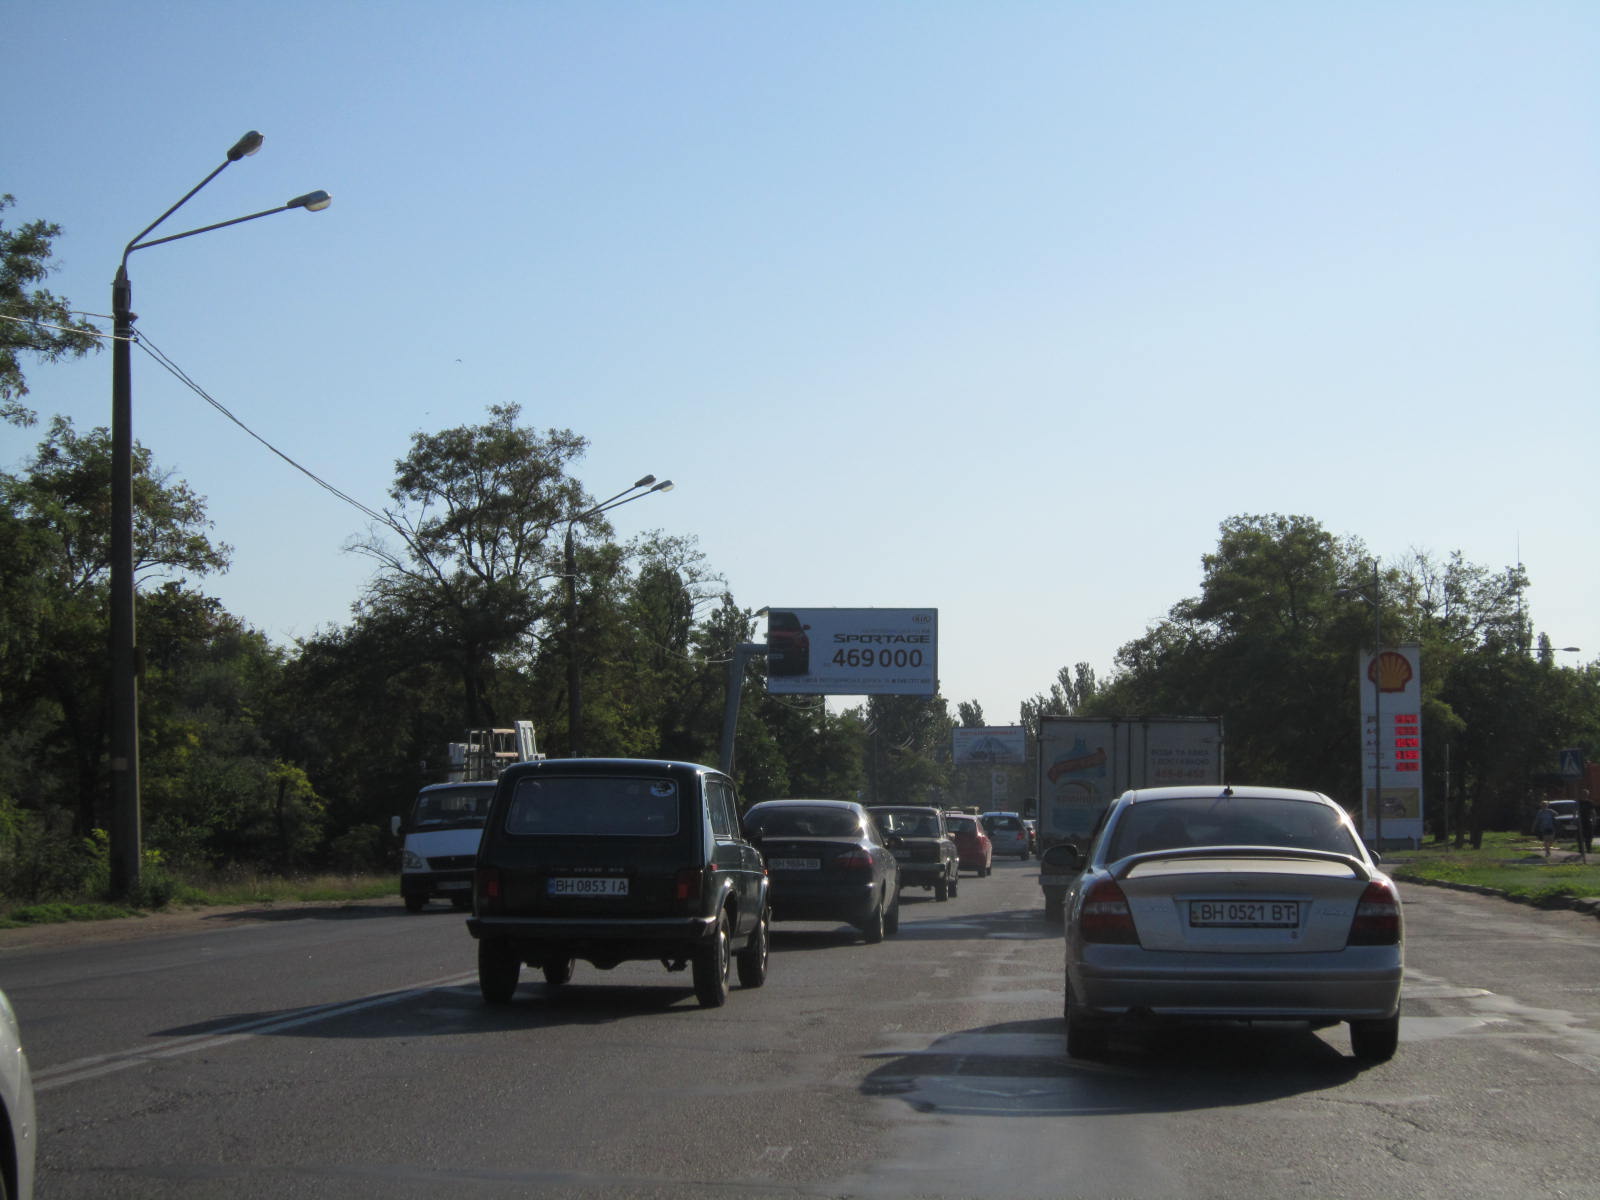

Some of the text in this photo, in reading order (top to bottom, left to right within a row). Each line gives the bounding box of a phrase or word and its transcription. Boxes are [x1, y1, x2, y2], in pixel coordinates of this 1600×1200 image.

[833, 633, 930, 644] SPORTAGE
[832, 649, 923, 667] 469 000
[556, 880, 626, 892] BH 0853 IA
[1201, 905, 1292, 920] BH 0521 BT
